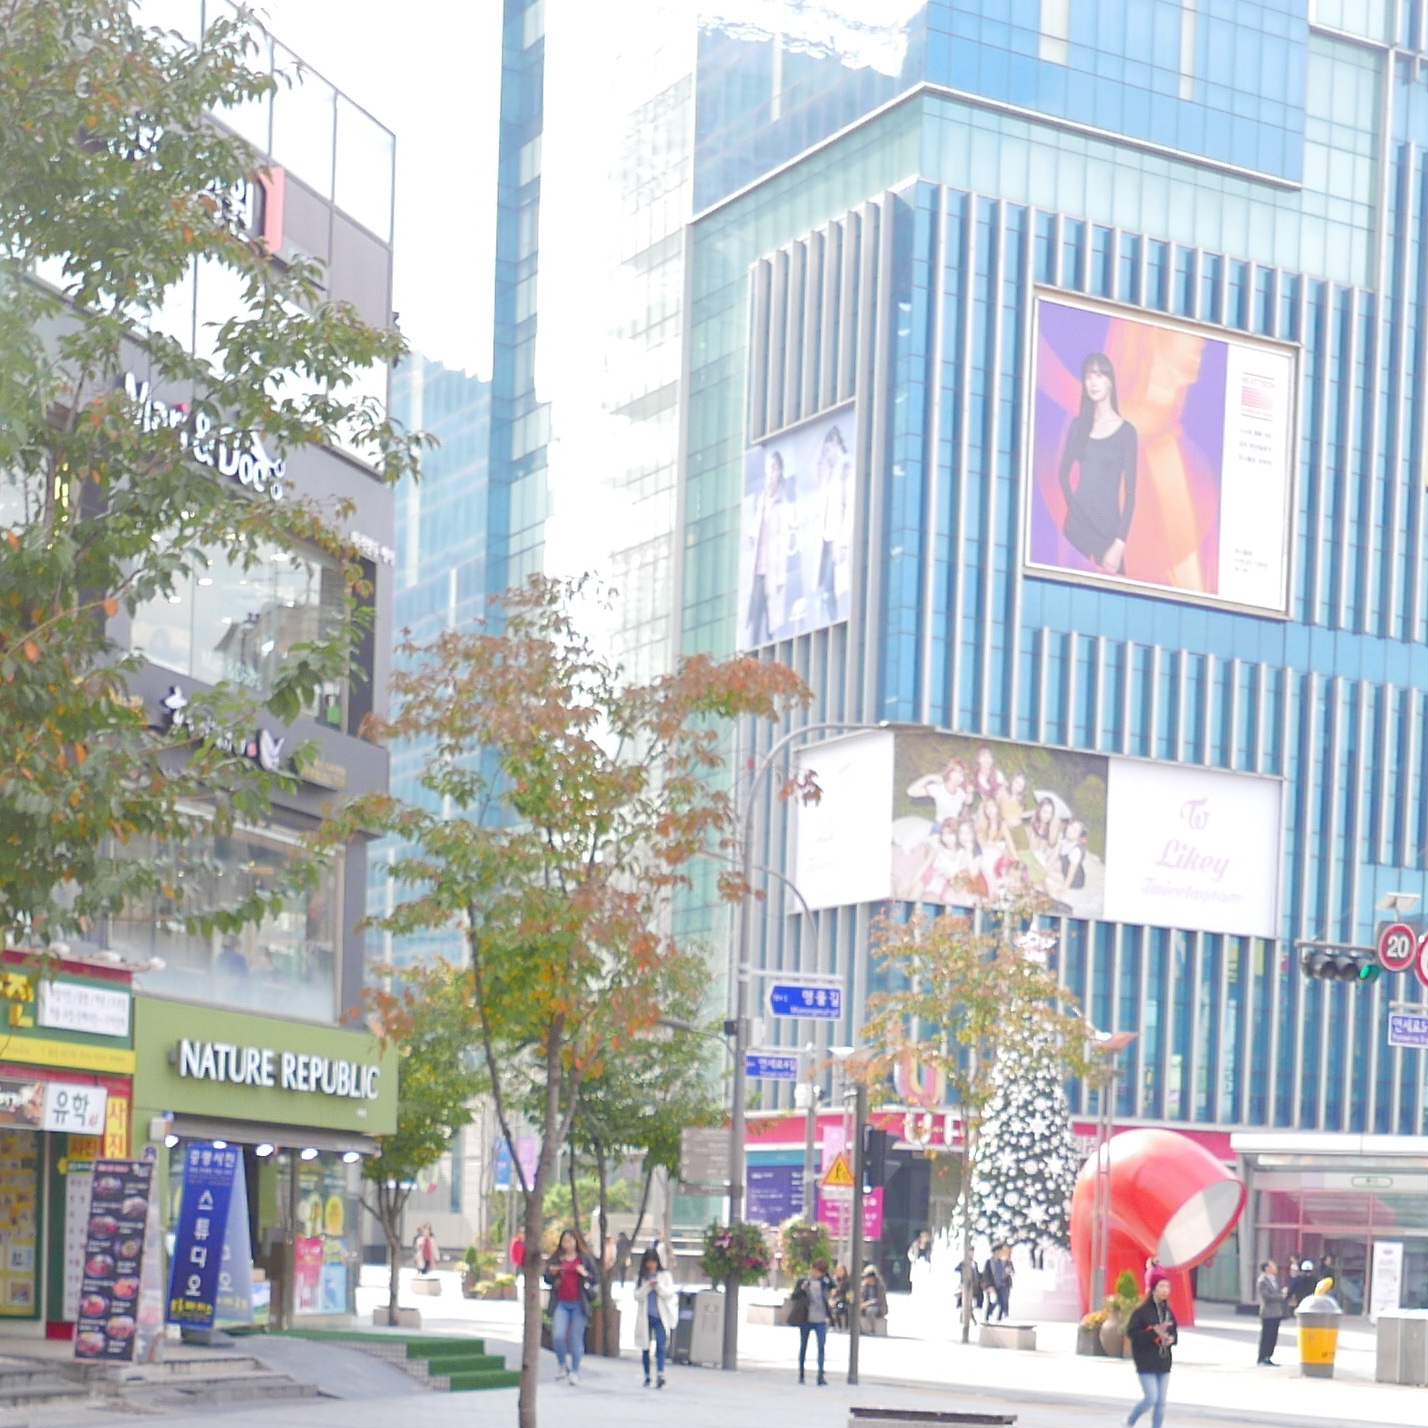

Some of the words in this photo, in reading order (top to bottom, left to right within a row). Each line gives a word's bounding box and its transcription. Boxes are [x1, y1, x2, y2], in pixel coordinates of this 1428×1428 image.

[1155, 838, 1231, 882] Likey
[1387, 935, 1409, 959] 20
[180, 1038, 275, 1087] NATURE
[281, 1051, 380, 1099] REPUBLIC
[52, 1090, 91, 1127] 유학
